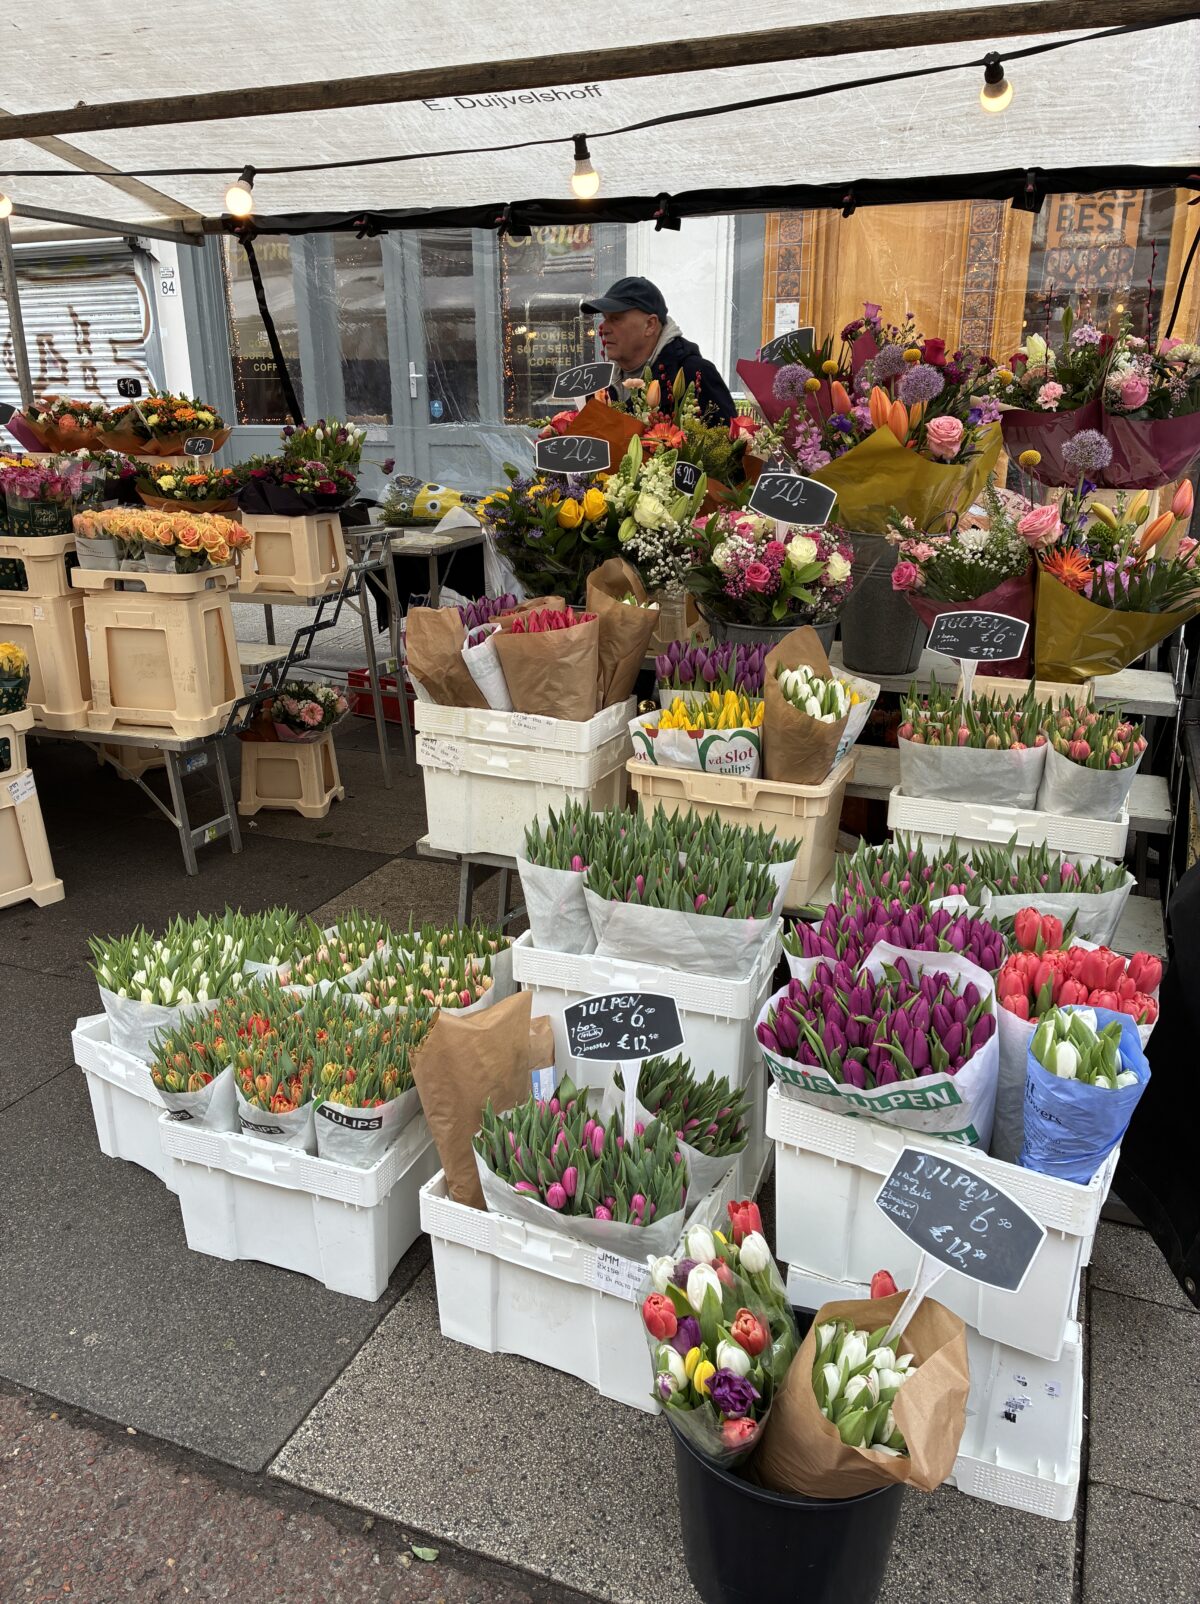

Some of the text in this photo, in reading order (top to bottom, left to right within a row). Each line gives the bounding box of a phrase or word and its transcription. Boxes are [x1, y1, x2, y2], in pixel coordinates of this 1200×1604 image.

[422, 85, 602, 112] E. Duijvelshoff
[1056, 202, 1135, 234] BEST
[161, 281, 175, 295] 84
[516, 344, 546, 354] SOFT
[253, 362, 289, 372] COFF
[529, 357, 572, 367] COFFEE
[940, 616, 1005, 630] TULPEN
[725, 746, 755, 764] Slot
[719, 763, 751, 775] tulips
[579, 995, 641, 1017] TULPEN
[842, 1087, 951, 1111] ULPEN
[323, 1105, 380, 1129] TULIPS
[913, 1155, 998, 1202] TULPEN
[598, 1253, 620, 1267] JMM
